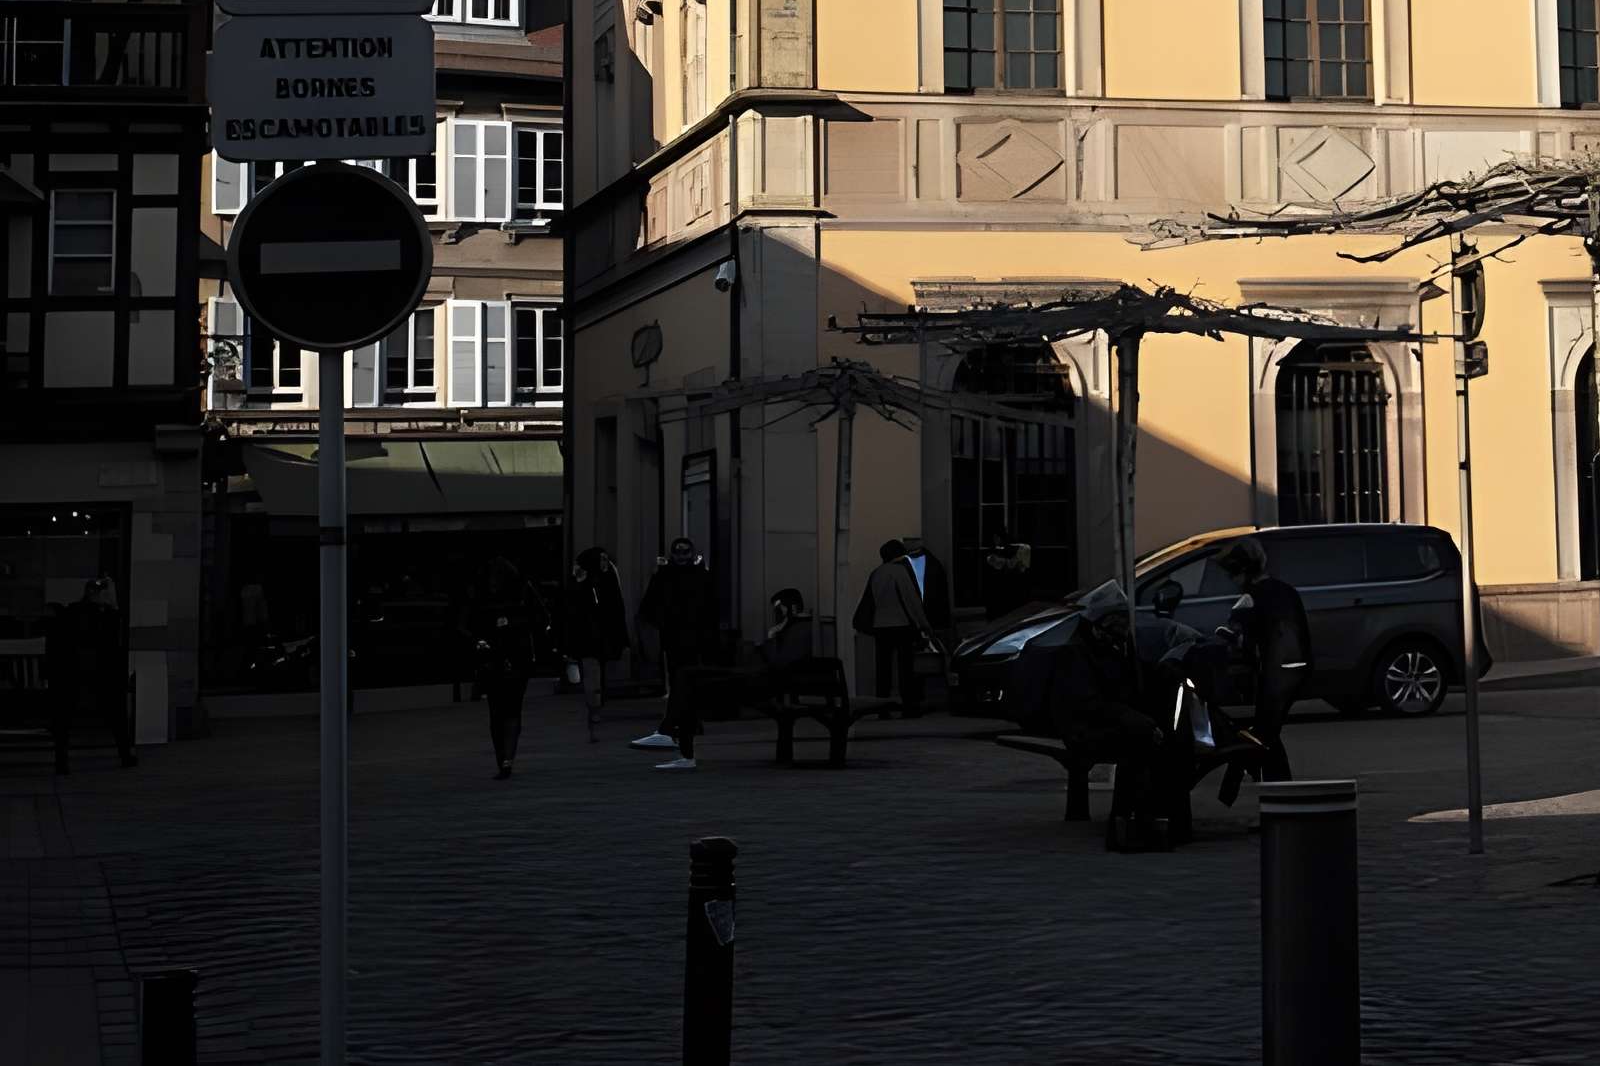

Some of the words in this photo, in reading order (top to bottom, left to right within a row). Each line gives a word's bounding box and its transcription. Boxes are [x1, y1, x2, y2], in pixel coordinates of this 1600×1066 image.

[260, 37, 393, 58] ATTENTION
[276, 77, 375, 99] BORNES
[225, 115, 425, 141] ESCAMOTABLES
